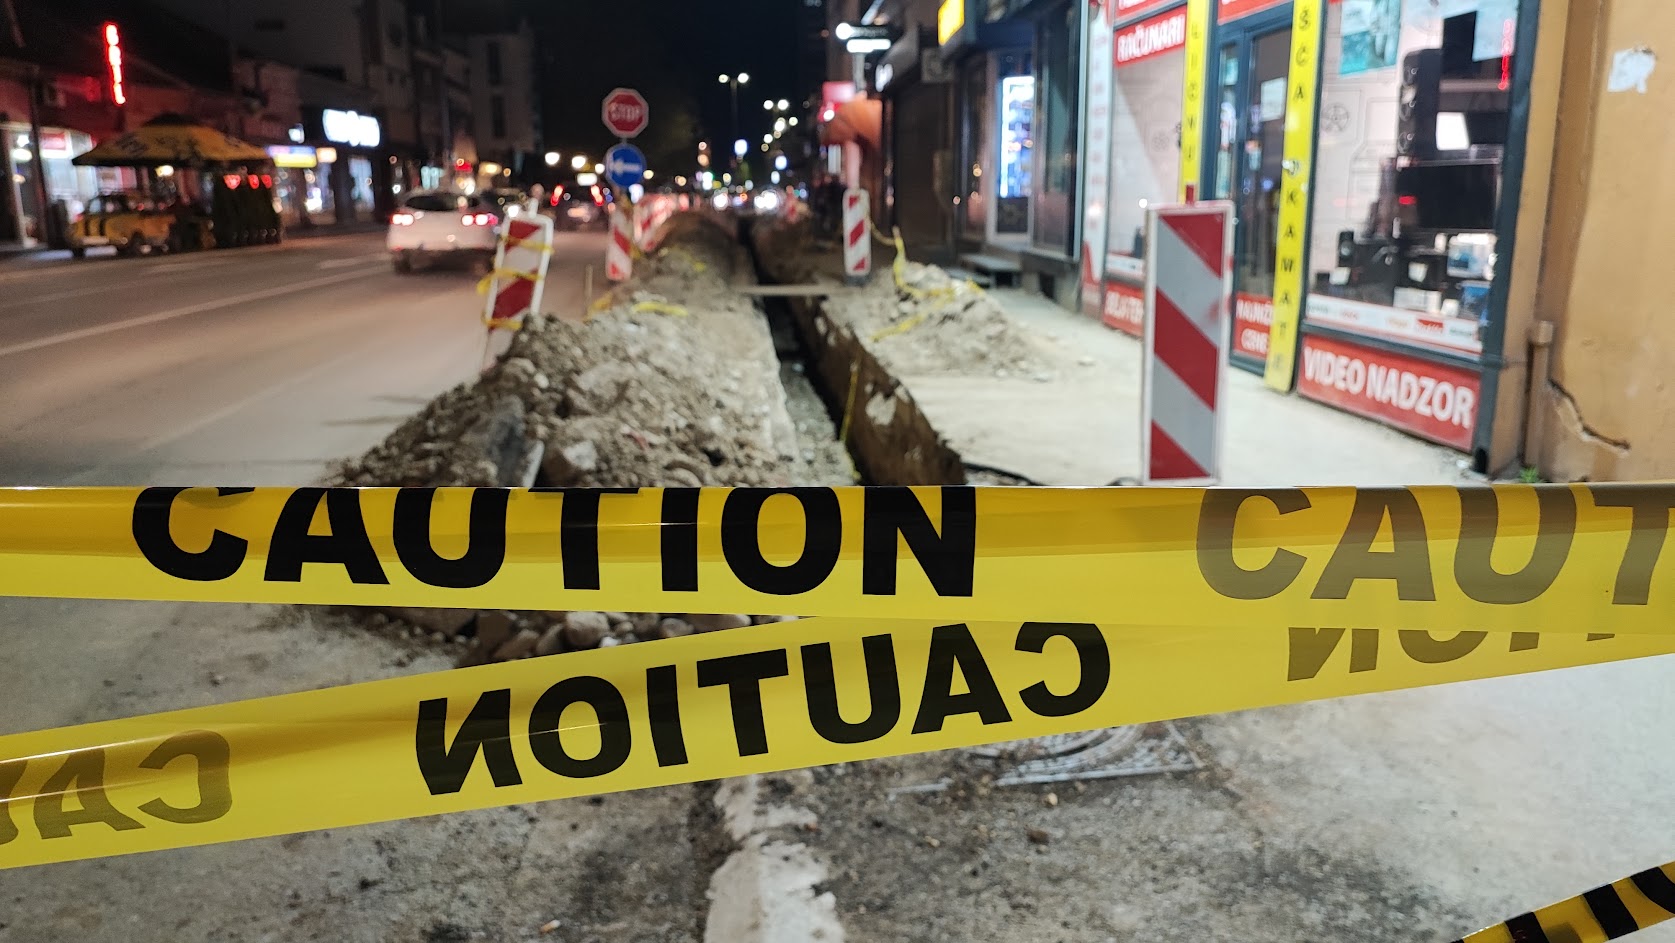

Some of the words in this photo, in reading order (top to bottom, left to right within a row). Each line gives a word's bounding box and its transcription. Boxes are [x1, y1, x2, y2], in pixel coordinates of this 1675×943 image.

[608, 102, 643, 122] STOP
[1304, 347, 1367, 394] VIDEO
[1365, 363, 1475, 428] NADZOR
[132, 487, 976, 597] CAUTION
